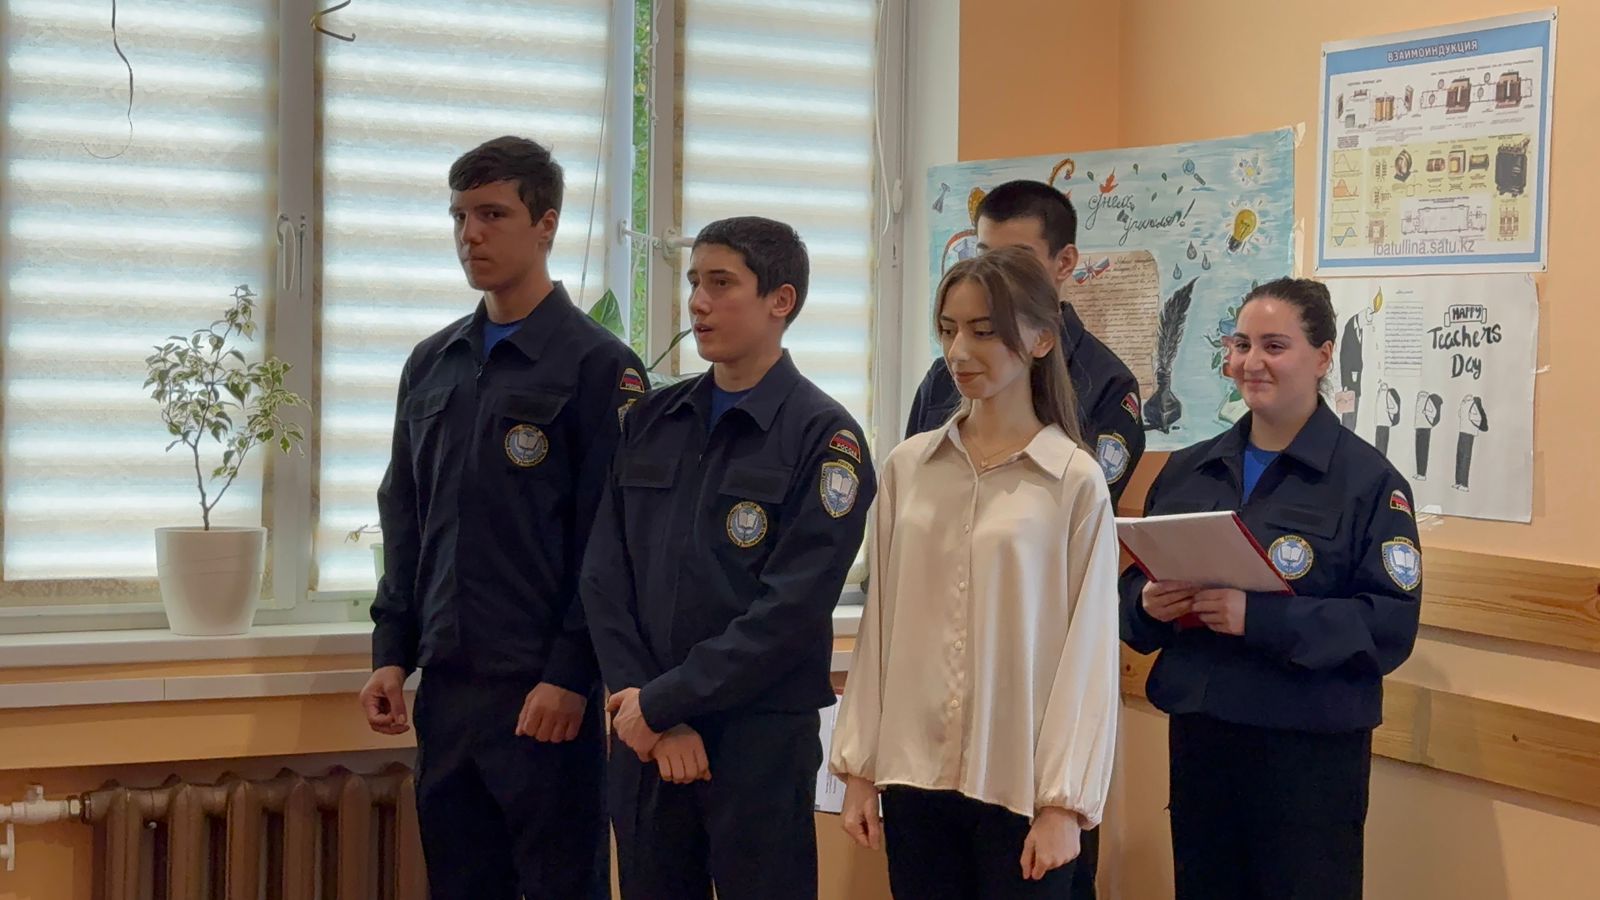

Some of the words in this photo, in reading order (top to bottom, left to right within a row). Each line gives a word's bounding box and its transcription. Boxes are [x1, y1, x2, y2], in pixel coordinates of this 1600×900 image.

[1387, 40, 1478, 62] ВЗАИМОИНДУКЦИЯ
[1452, 306, 1482, 320] HAPPY
[1427, 324, 1502, 350] Teachers
[1451, 353, 1482, 380] Day
